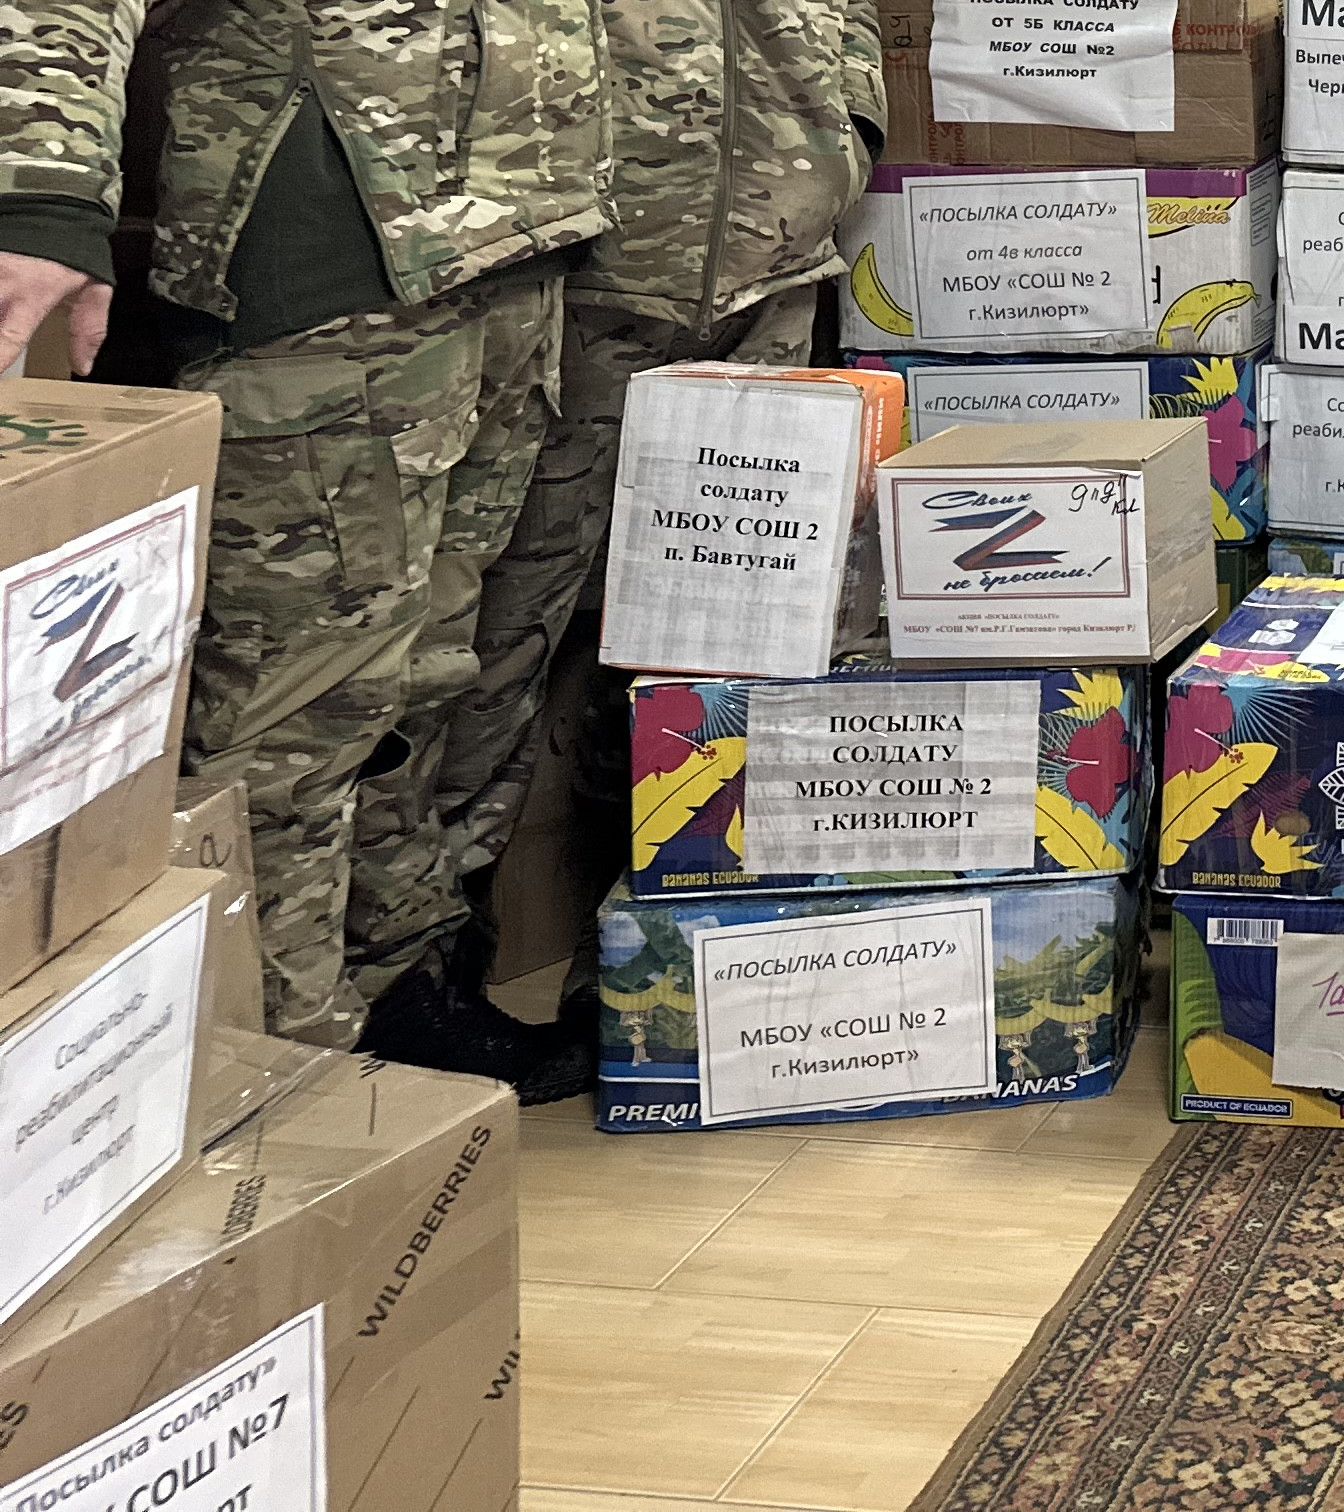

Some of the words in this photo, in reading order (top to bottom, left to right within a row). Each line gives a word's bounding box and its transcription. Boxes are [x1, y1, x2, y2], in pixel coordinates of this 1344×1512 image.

[991, 17, 1014, 30] ОТ
[1024, 18, 1044, 31] 5Б
[1053, 20, 1115, 33] КЛАССА
[989, 40, 1032, 54] МБОУ
[1039, 42, 1077, 55] СОШ
[1086, 44, 1115, 56] №2
[1002, 64, 1098, 80] г.Кизилюрт
[919, 206, 1018, 224] «ПОСЫЛКА
[1023, 202, 1117, 221] СОЛДАТУ»
[1147, 202, 1231, 226] Melina
[966, 247, 993, 261] от
[998, 245, 1019, 260] 4в
[1023, 243, 1083, 260] класса
[942, 274, 1002, 293] МБОУ
[1007, 271, 1065, 290] «СОШ
[1072, 271, 1094, 288] №
[1100, 270, 1112, 286] 2
[968, 303, 1089, 322] г.Кизилюрт»
[664, 546, 684, 564] п.
[691, 543, 796, 574] Бавтугай
[829, 714, 964, 735] ПОСЫЛКА
[832, 744, 959, 765] СОЛДАТУ
[813, 811, 979, 833] г.КИЗИЛЮРТ
[1192, 871, 1237, 887] BANANAS
[1238, 872, 1281, 889] ECUADOR
[356, 1123, 491, 1339] WILDBERRIES
[157, 1354, 277, 1445] солдату»
[226, 1393, 290, 1464] №7
